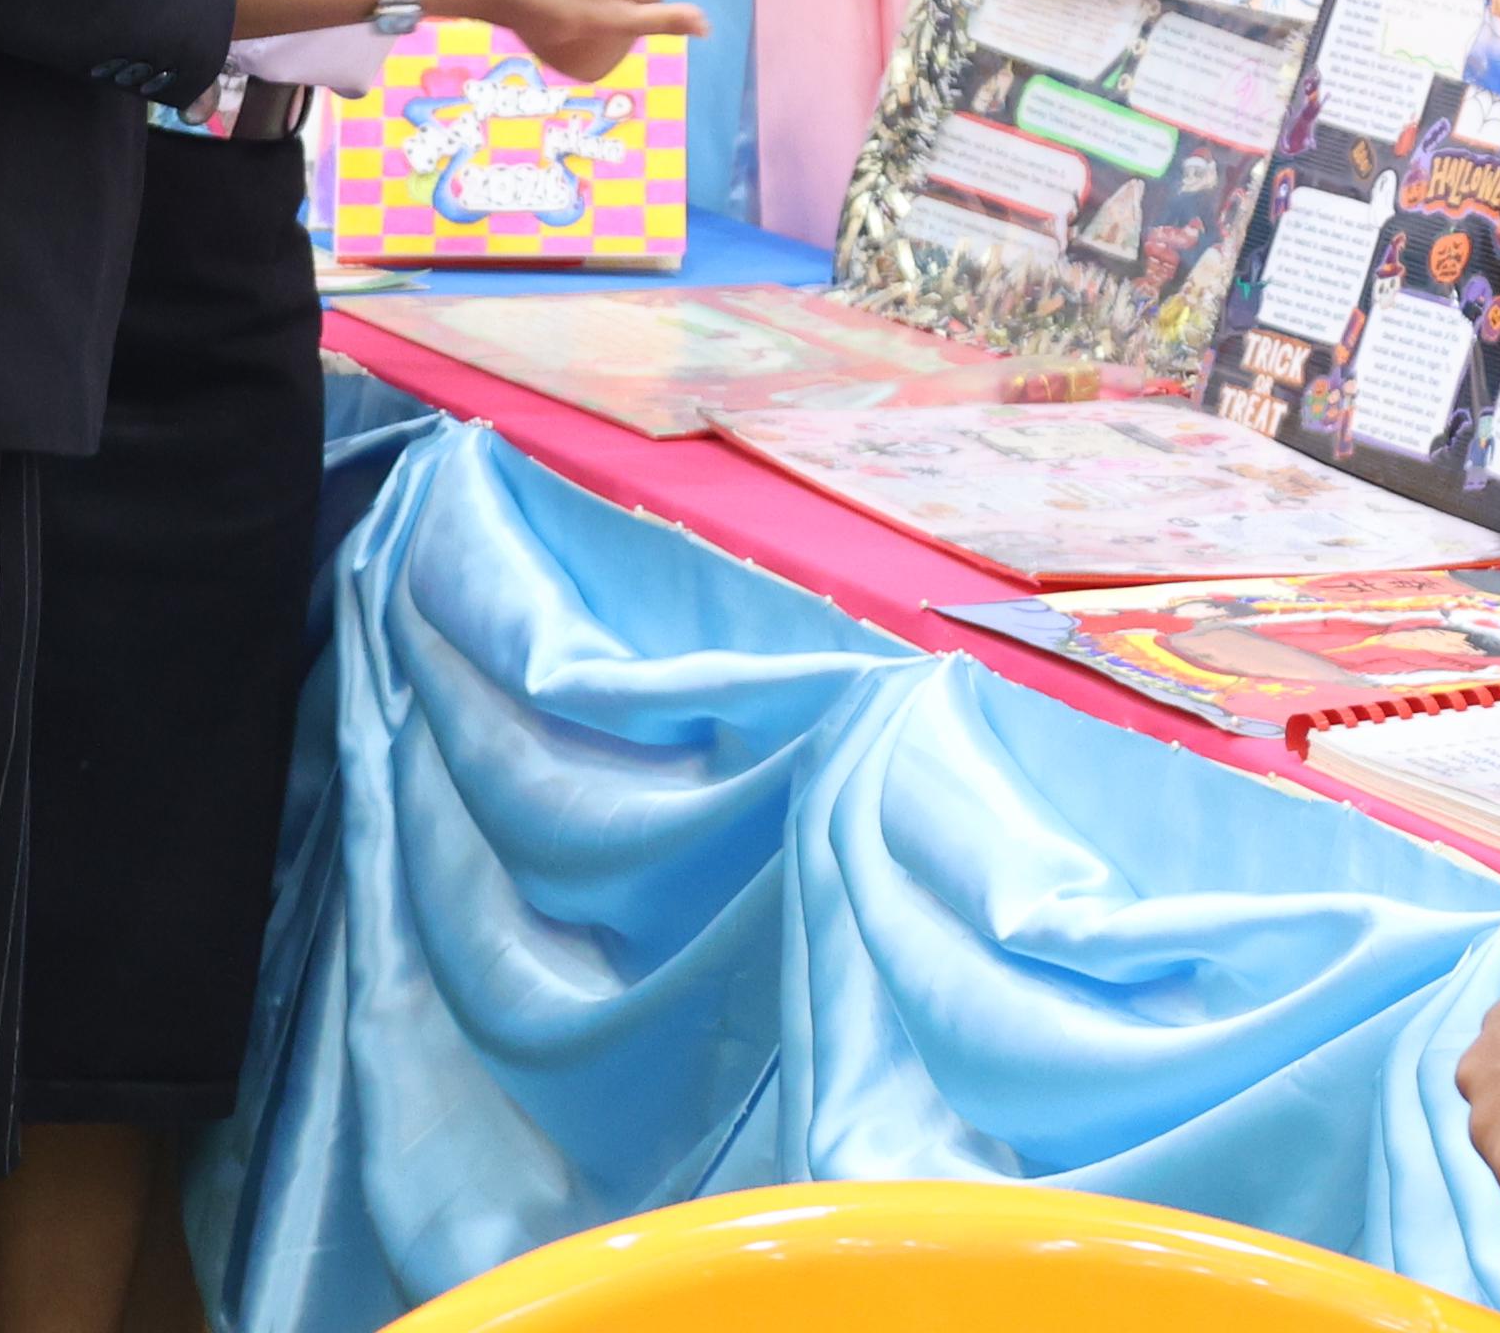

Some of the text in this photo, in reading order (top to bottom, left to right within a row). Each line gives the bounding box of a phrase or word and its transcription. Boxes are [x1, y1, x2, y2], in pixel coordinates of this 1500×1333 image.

[1245, 333, 1311, 382] TRICK
[1256, 374, 1273, 395] OR
[1222, 386, 1288, 438] TREAT
